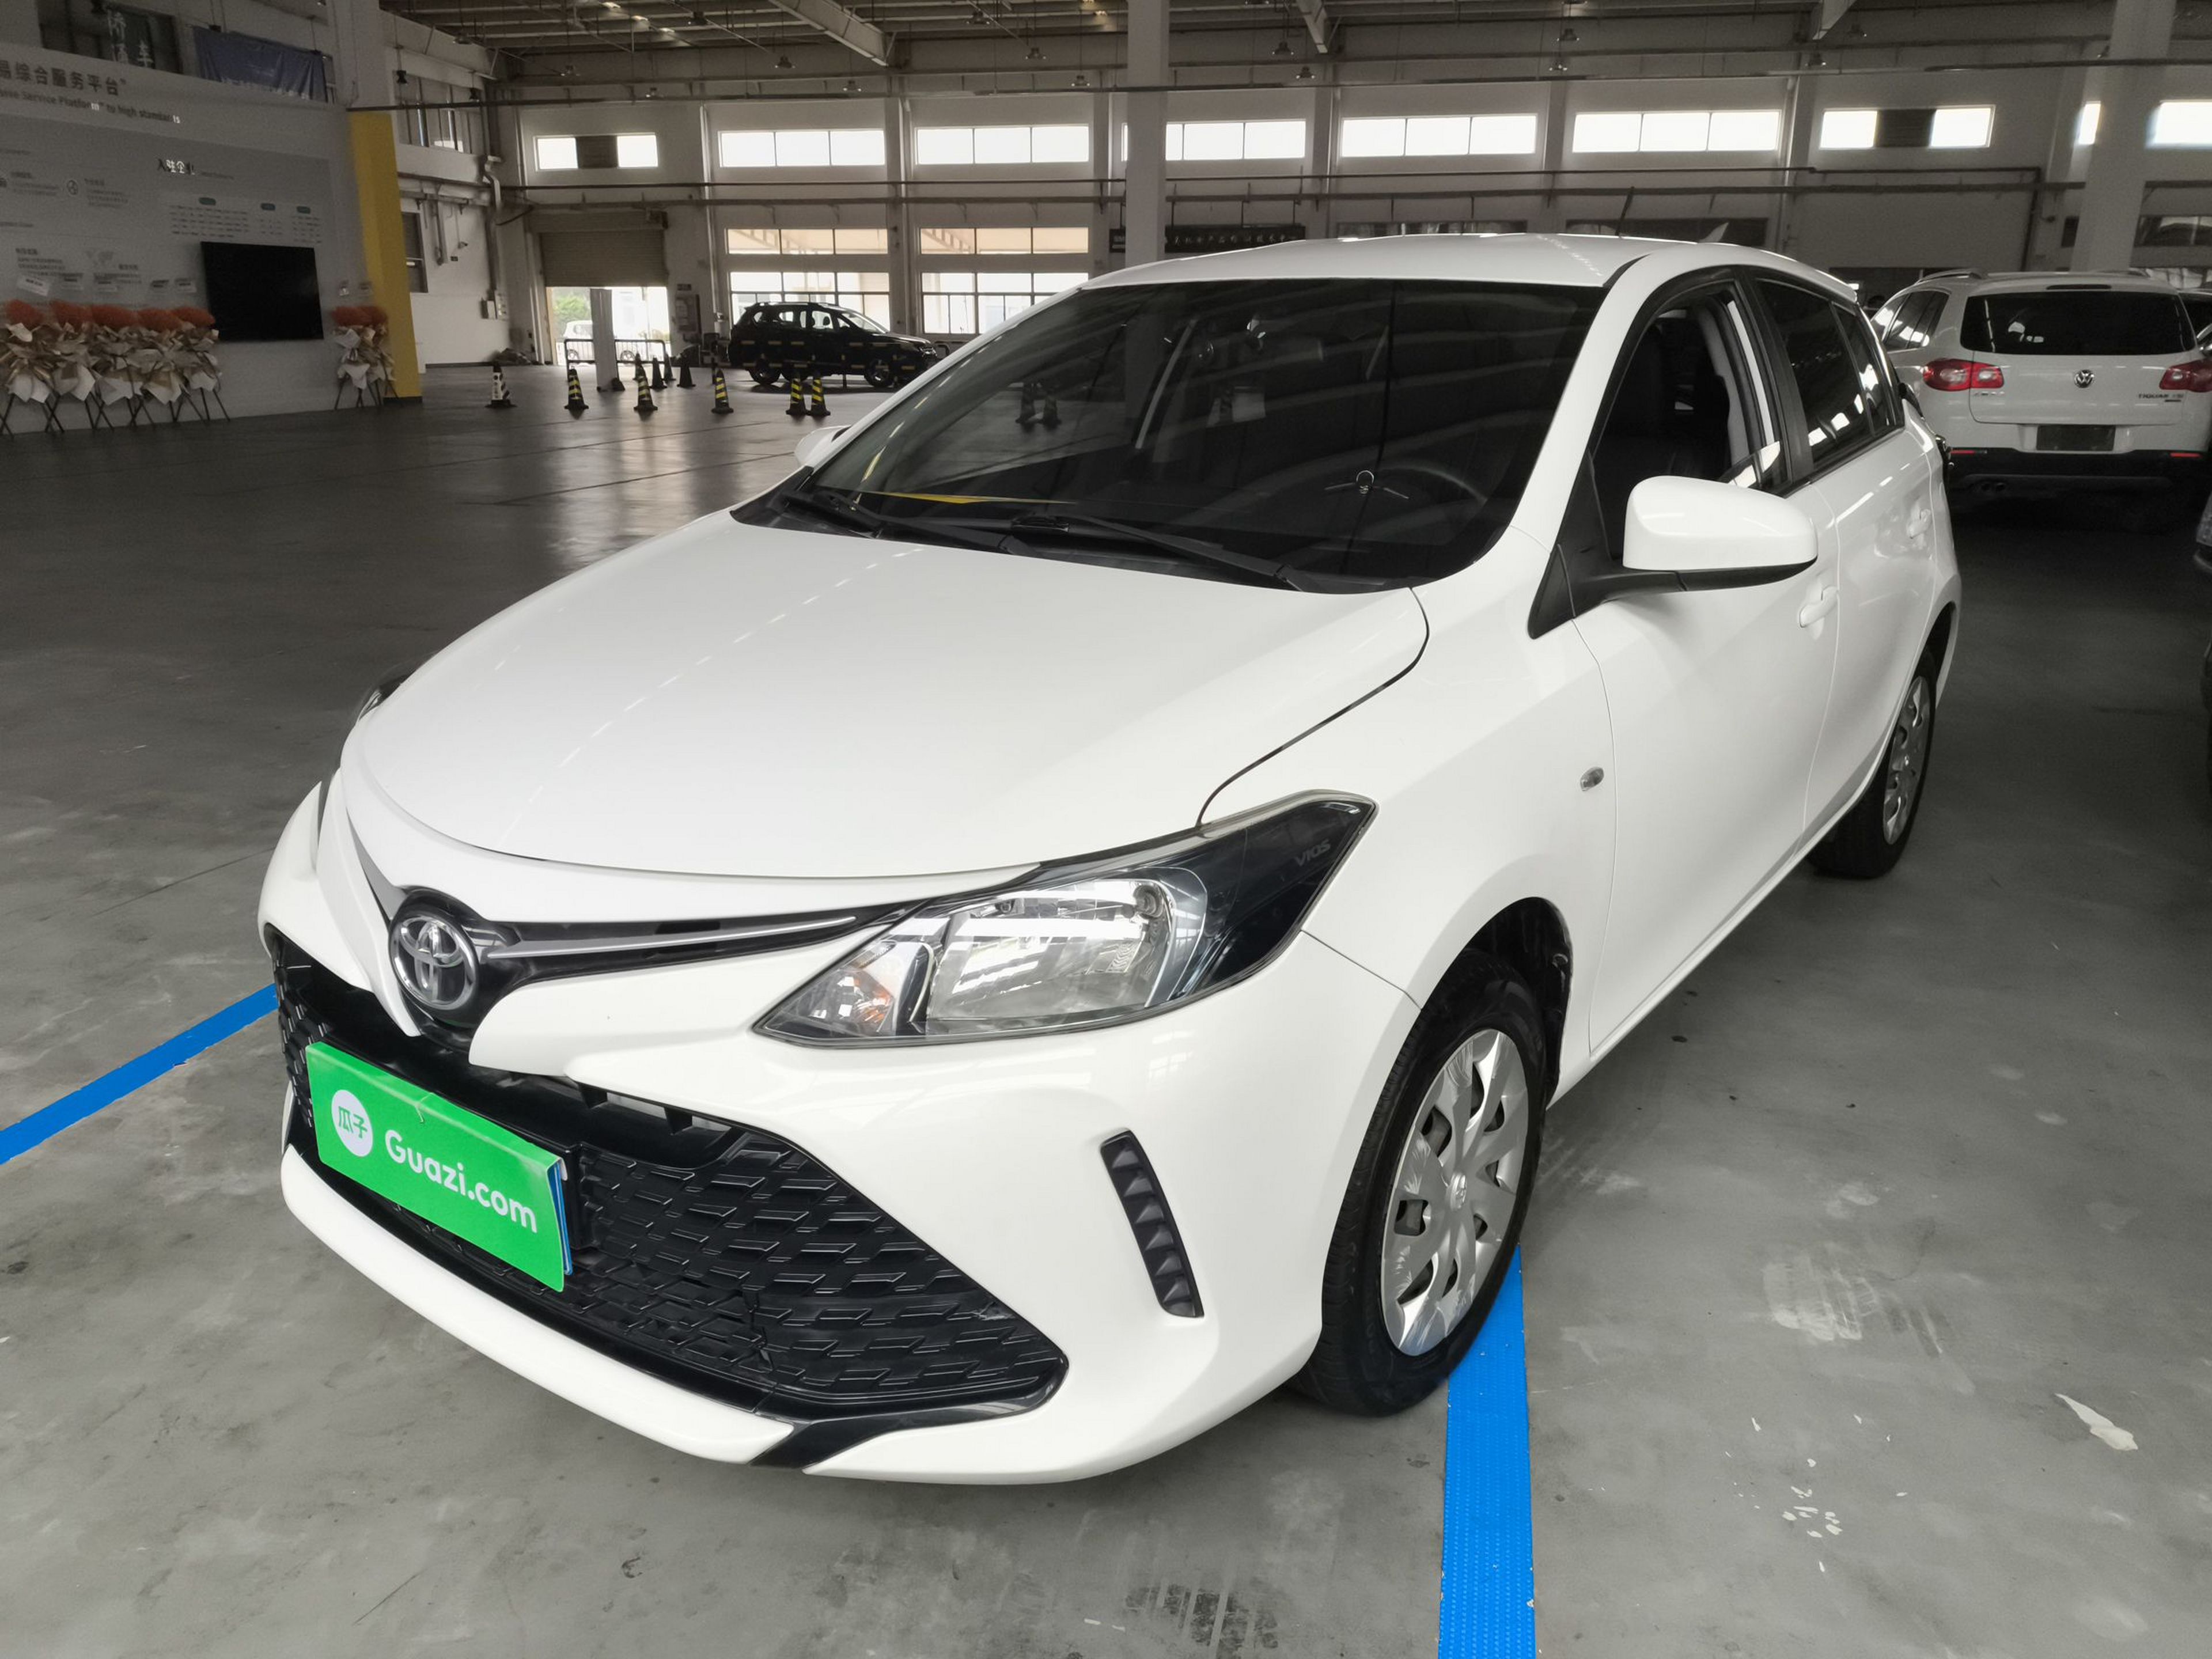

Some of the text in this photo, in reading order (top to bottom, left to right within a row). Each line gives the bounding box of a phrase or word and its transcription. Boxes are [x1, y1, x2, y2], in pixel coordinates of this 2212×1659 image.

[1295, 839, 1331, 866] VIOS
[338, 1105, 368, 1139] 瓜子
[385, 1129, 538, 1233] Guazi.com
